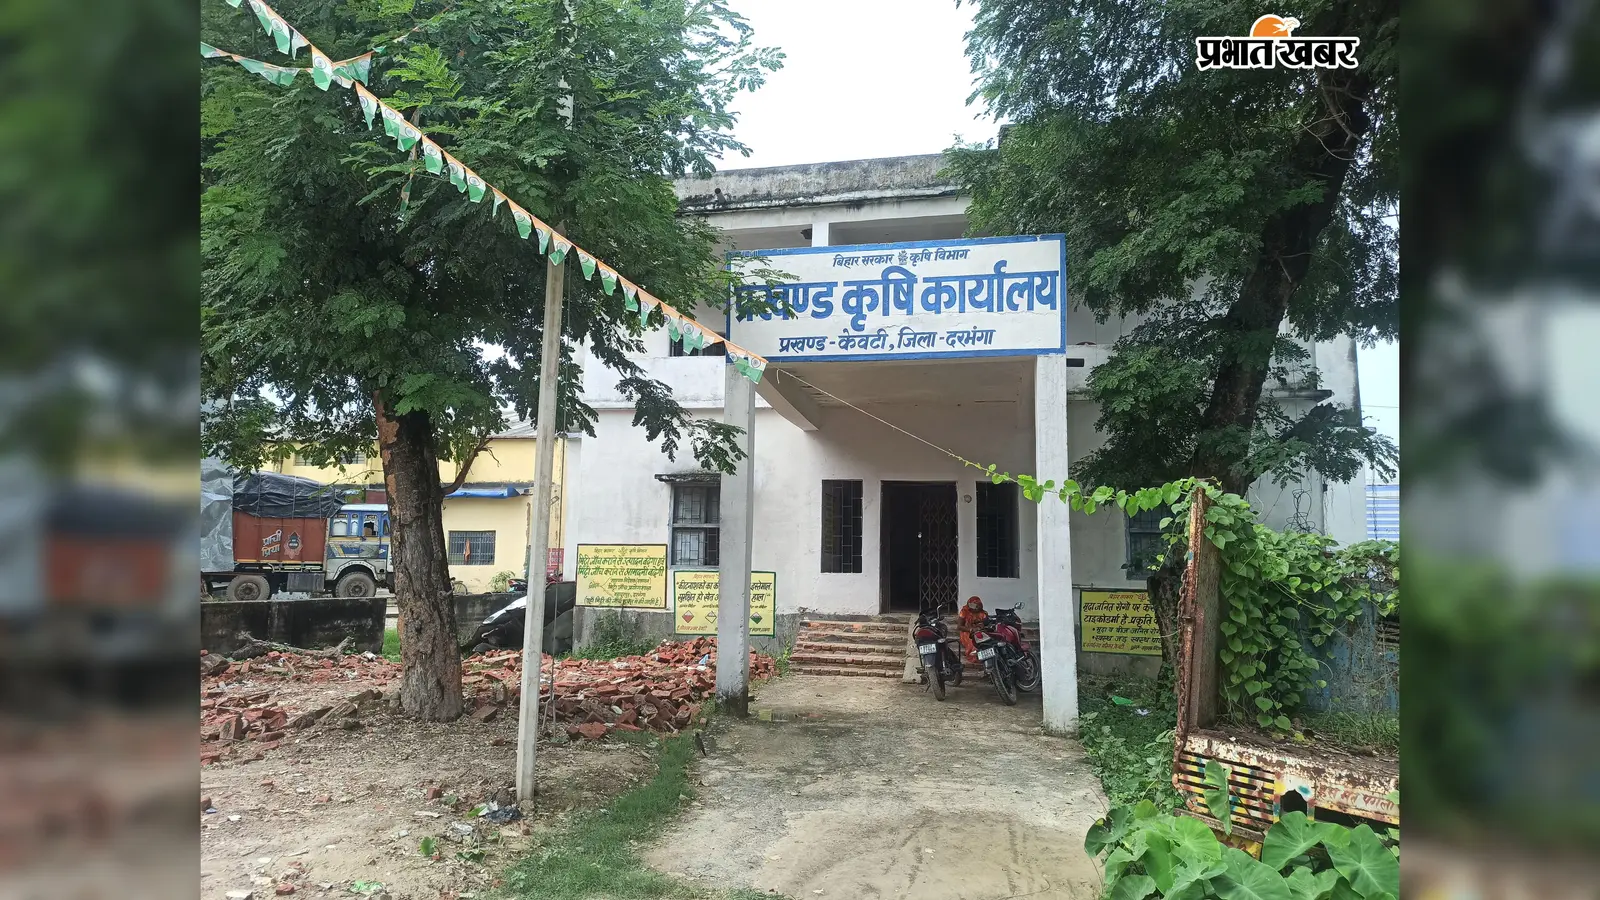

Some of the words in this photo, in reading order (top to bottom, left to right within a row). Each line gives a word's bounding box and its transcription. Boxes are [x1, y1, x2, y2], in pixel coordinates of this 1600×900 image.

[833, 254, 860, 268] बिहार
[862, 254, 894, 266] सरकार
[909, 249, 933, 266] कृषि
[934, 248, 970, 261] विभाग
[842, 265, 918, 331] कृषि
[921, 259, 1059, 314] कार्यालय
[896, 326, 938, 349] जिला
